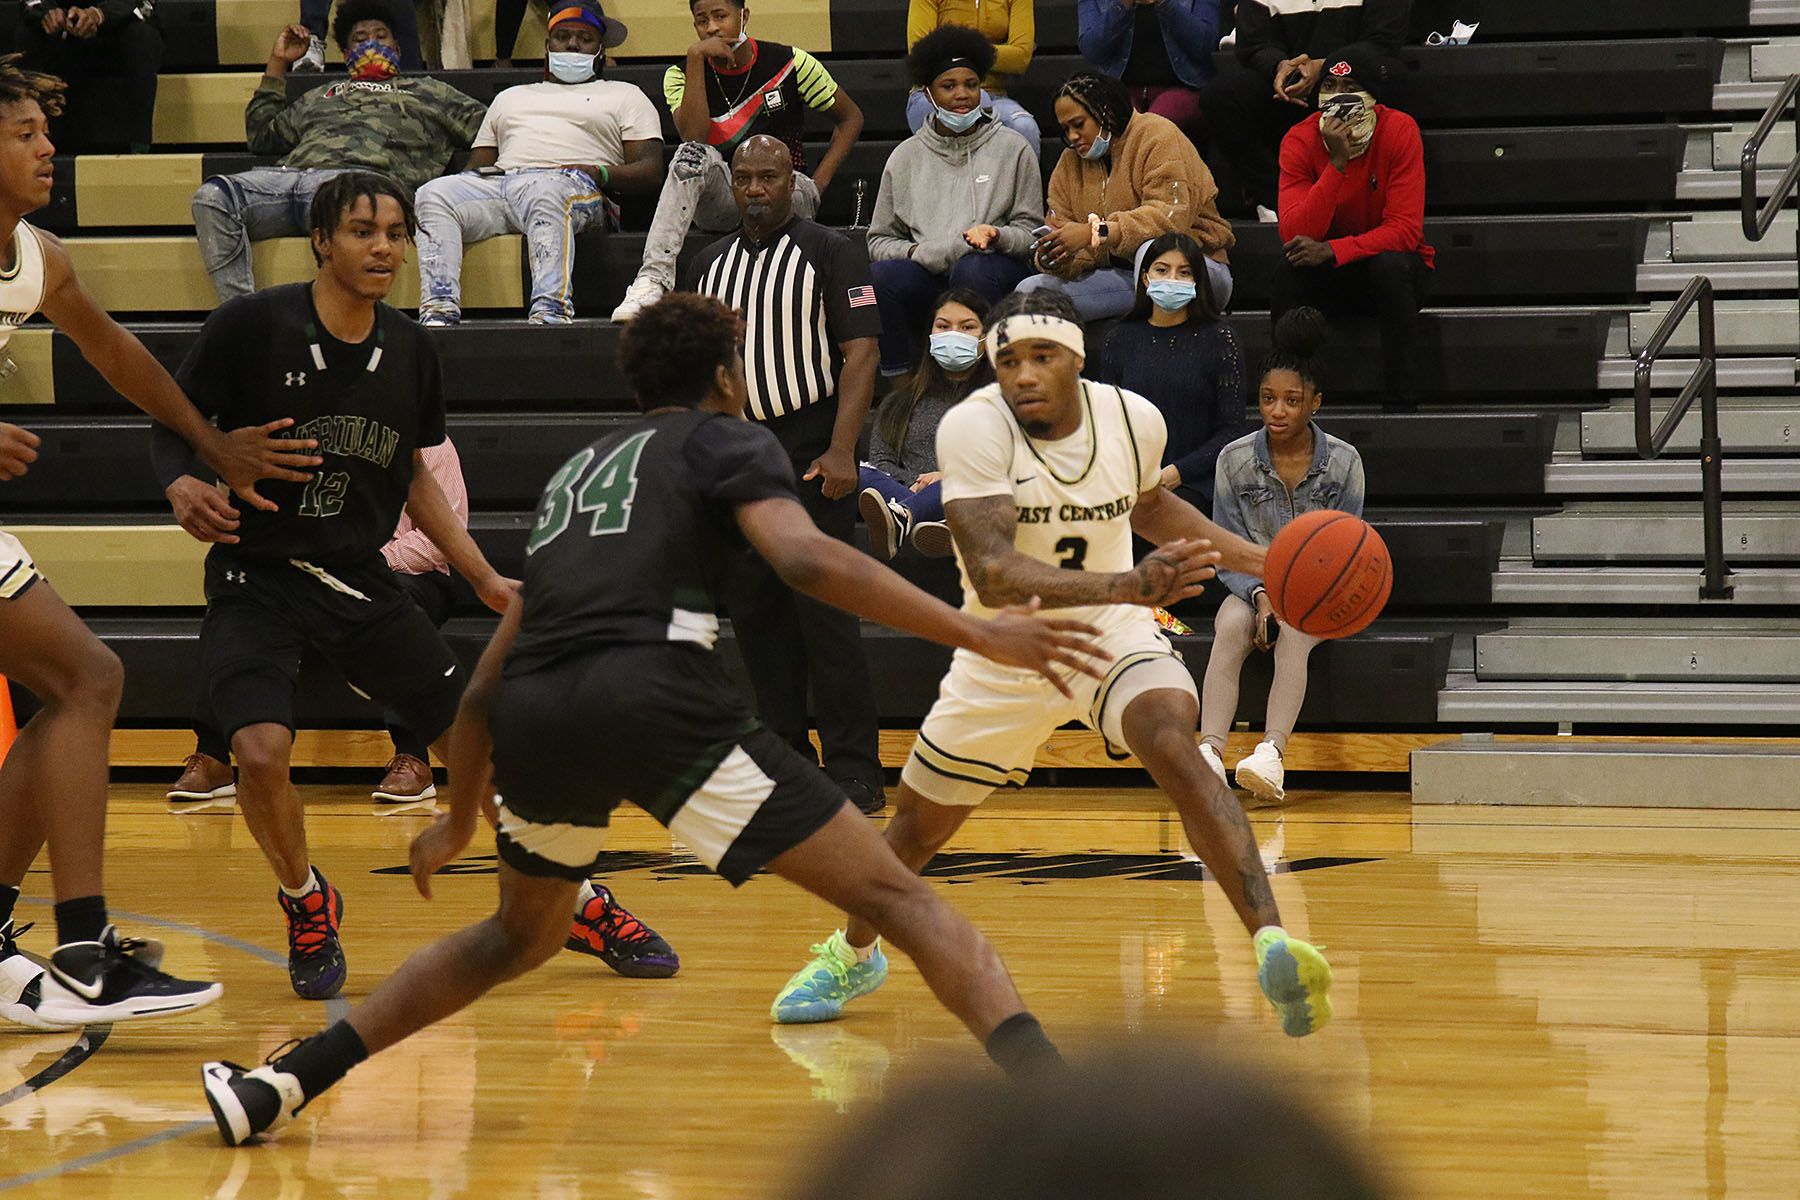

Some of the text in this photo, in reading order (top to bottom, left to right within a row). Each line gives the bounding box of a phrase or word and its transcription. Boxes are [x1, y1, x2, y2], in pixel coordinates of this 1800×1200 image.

[1783, 428, 1790, 436] C
[299, 471, 351, 517] 12
[526, 429, 657, 556] 34
[1015, 495, 1132, 523] AST CENTRAL
[1690, 656, 1698, 664] A
